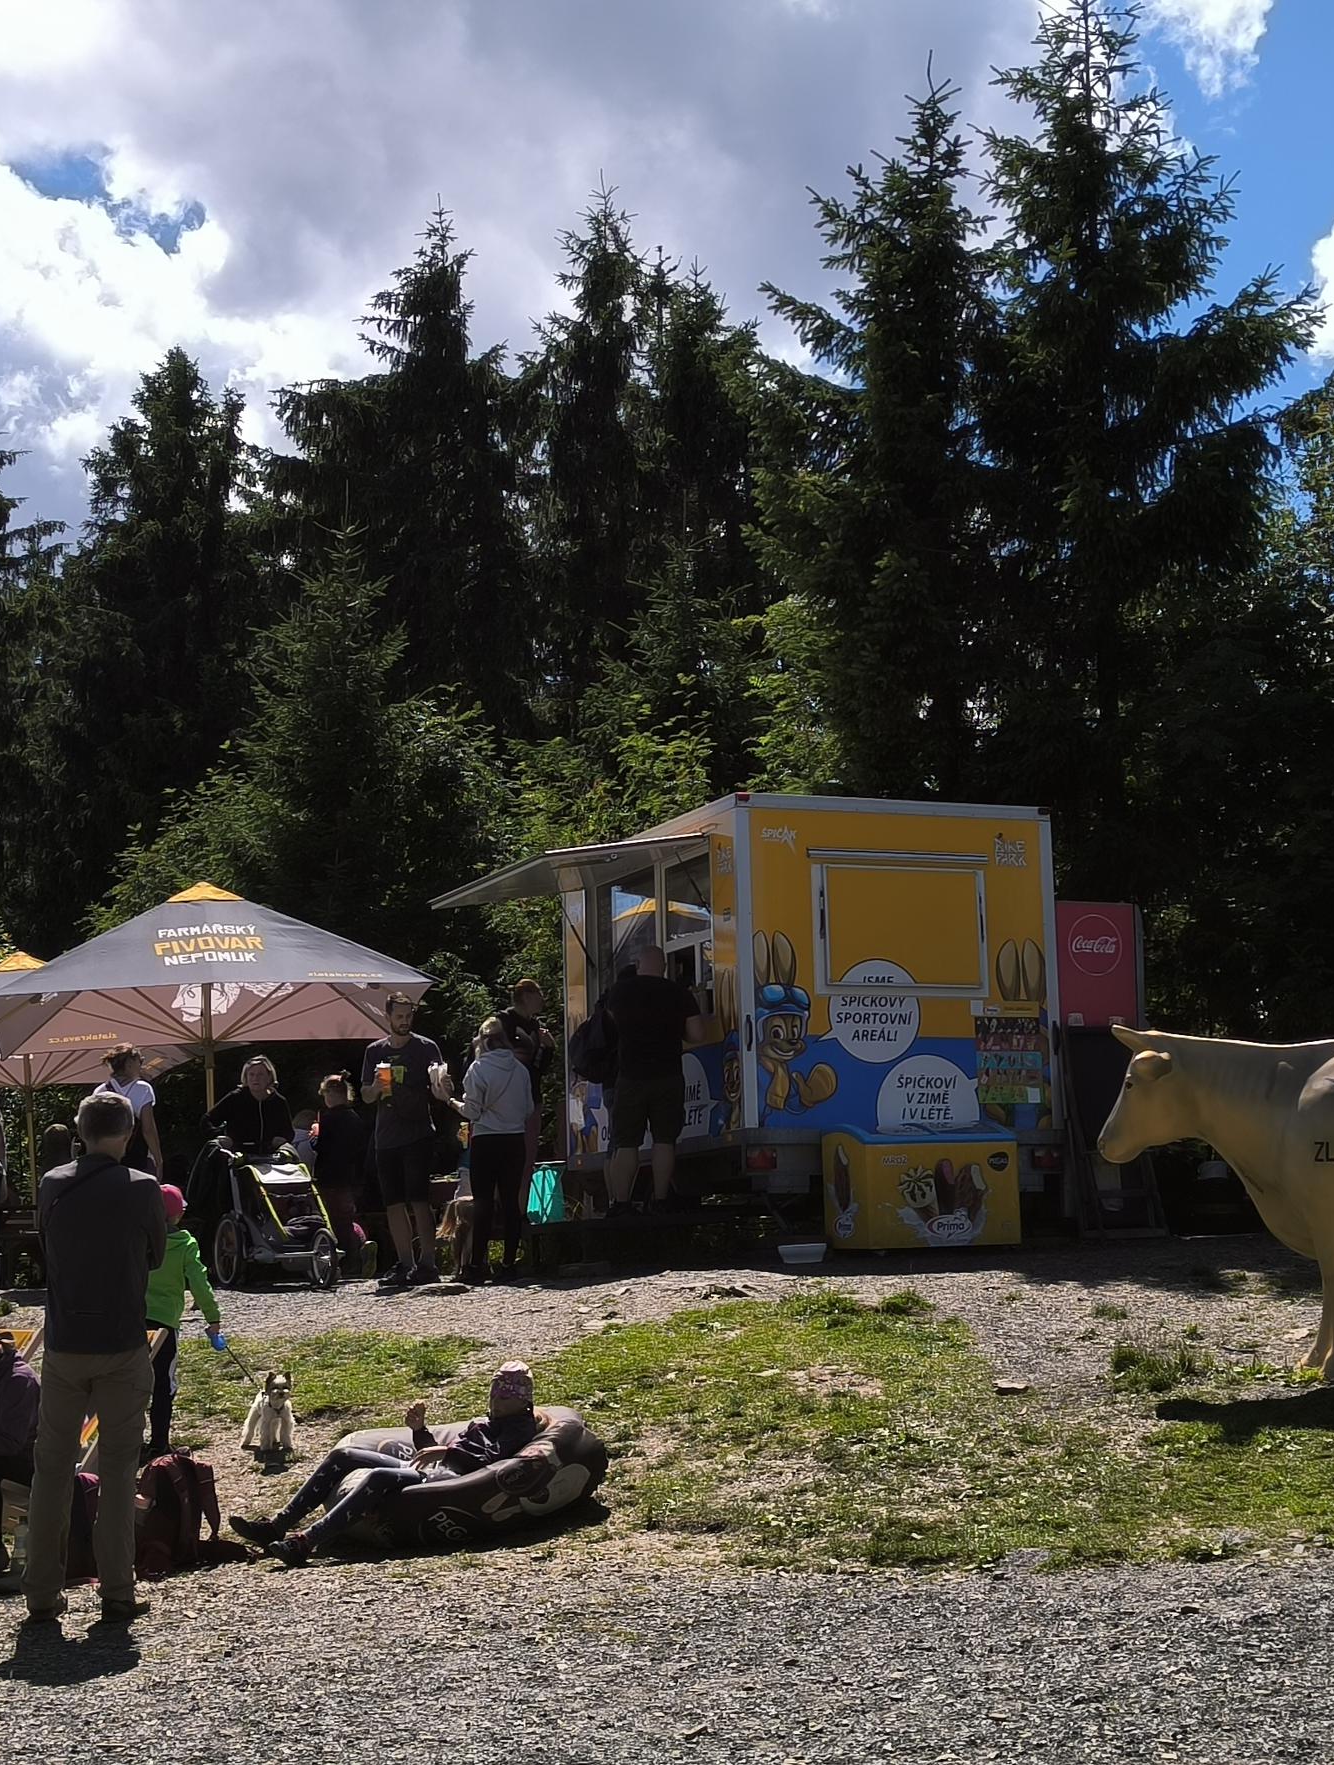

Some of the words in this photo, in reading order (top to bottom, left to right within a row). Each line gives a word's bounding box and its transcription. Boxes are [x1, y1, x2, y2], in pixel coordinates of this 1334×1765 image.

[995, 838, 1026, 852] BIKE
[995, 853, 1028, 866] PARK
[153, 936, 264, 956] PIVOVAR
[163, 951, 258, 966] NEPOMUK
[835, 1011, 913, 1026] SPORTOVNÍ
[896, 1073, 958, 1089] ŠPIČKOVÍ
[685, 1081, 701, 1101] IMĚ
[906, 1092, 915, 1104] V
[917, 1090, 950, 1105] ZIMĚ
[909, 1107, 919, 1120] V
[920, 1105, 954, 1121] LÉTĚ.
[936, 1220, 965, 1232] Prima
